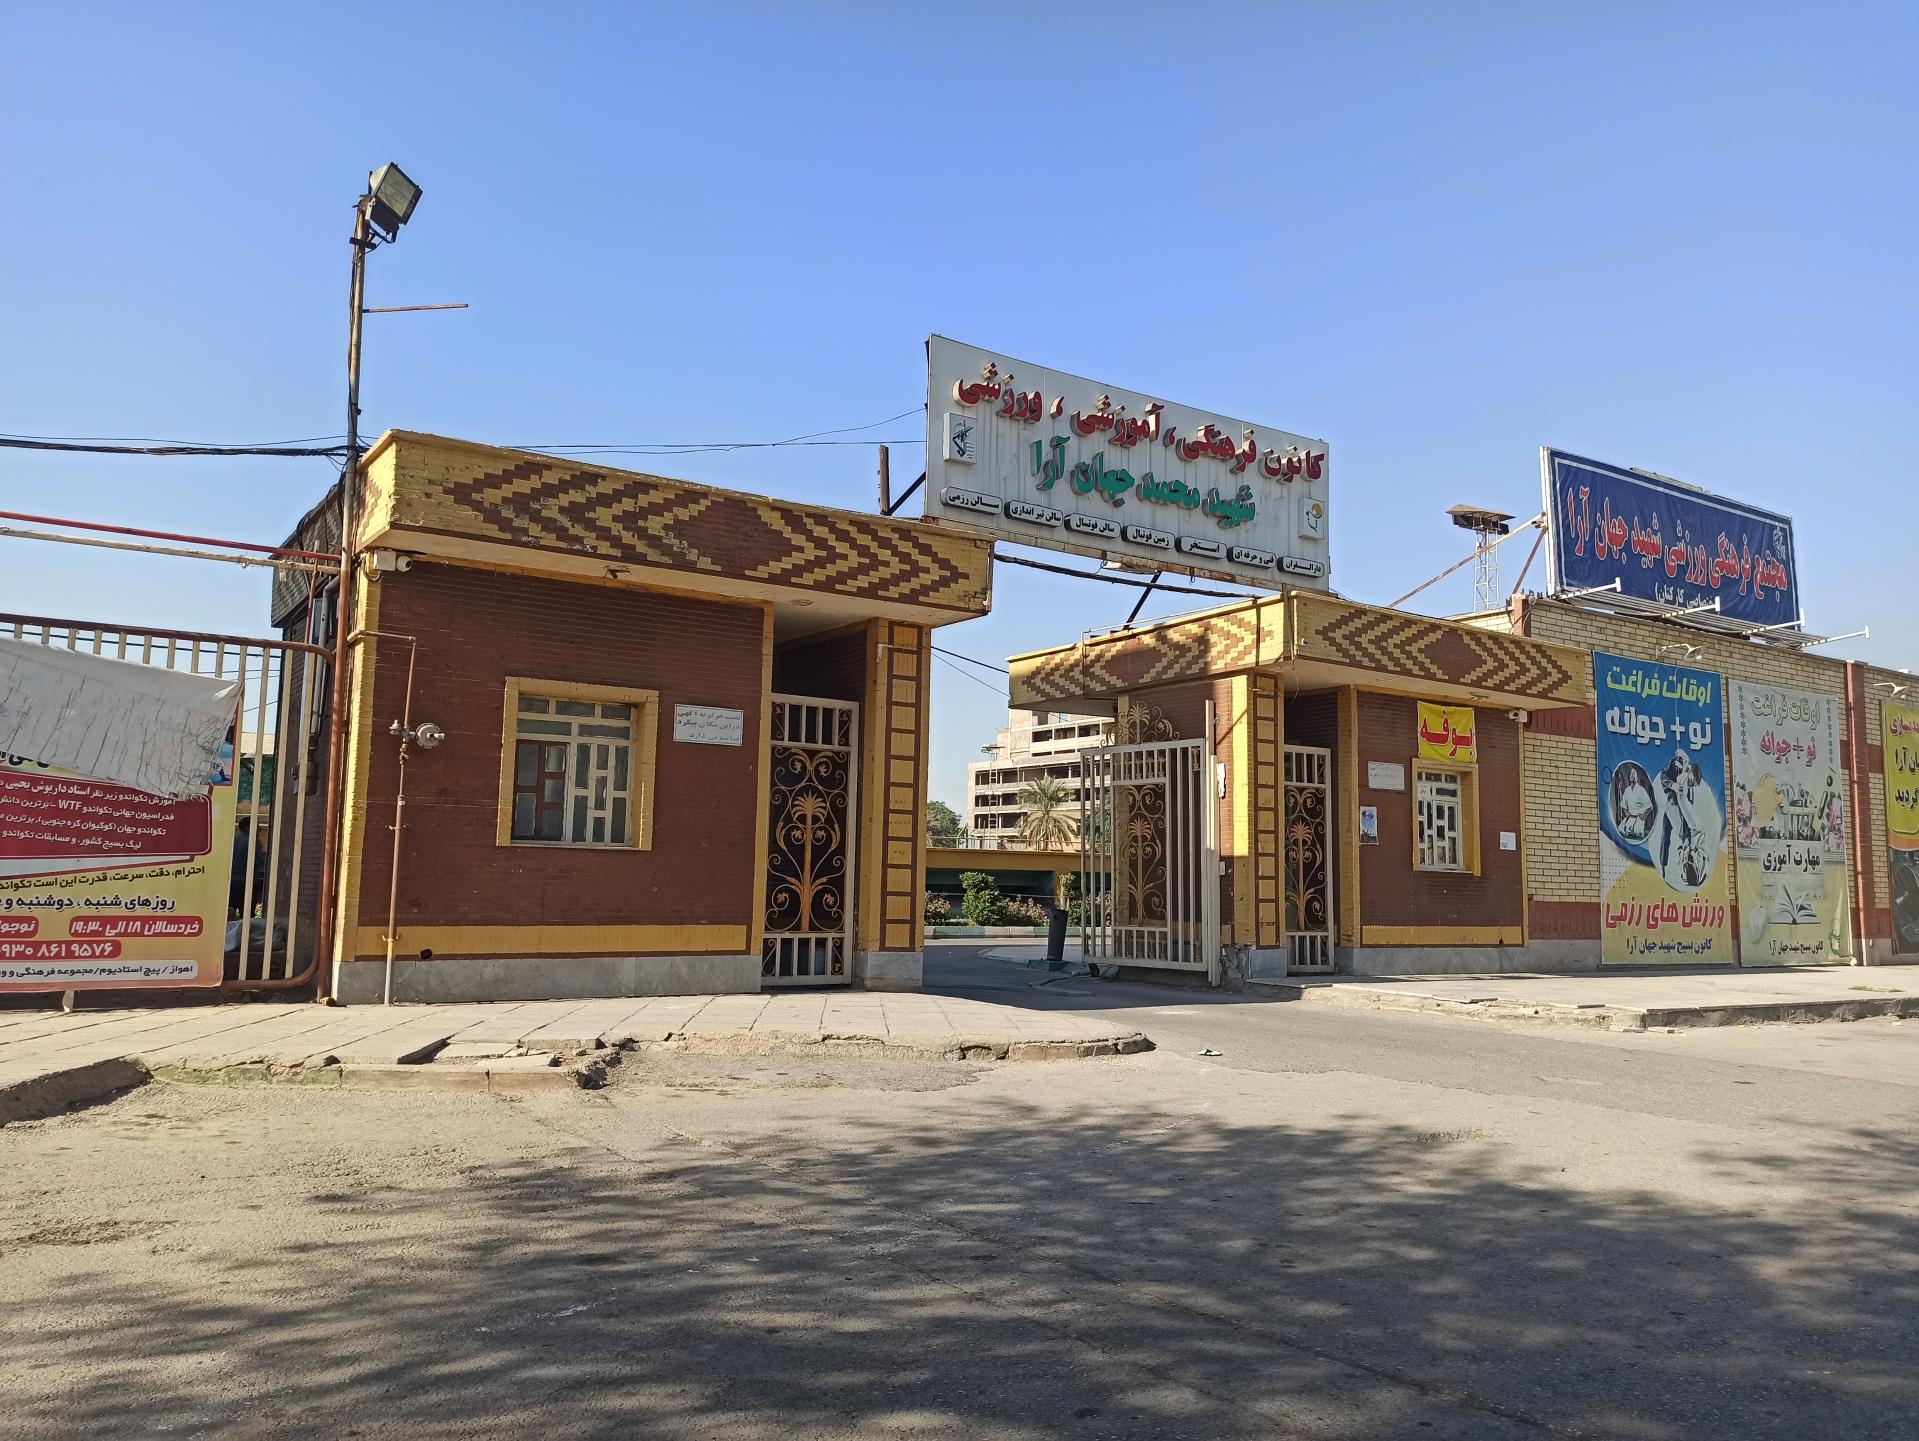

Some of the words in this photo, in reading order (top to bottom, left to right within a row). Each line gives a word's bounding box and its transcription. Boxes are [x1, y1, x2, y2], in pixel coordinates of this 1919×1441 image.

[953, 362, 1043, 424] ورزشی
[1030, 435, 1071, 491] آرا
[1259, 445, 1325, 485] کانون
[1070, 450, 1135, 509] جهان
[1136, 471, 1201, 510] محمد
[948, 492, 969, 506] رزمی
[971, 496, 999, 509] سالن
[1202, 484, 1256, 529] شهید
[1011, 504, 1034, 516] اندازی
[1034, 508, 1045, 520] تیر
[1045, 511, 1062, 523] سالن
[1075, 517, 1099, 532] فوتسال
[1099, 520, 1115, 533] سالن
[1567, 485, 1590, 556] آرا
[1132, 528, 1152, 543] فوتبال
[1595, 497, 1628, 565] جهان
[1153, 535, 1170, 546] زمین
[1188, 539, 1220, 553] استخر
[1631, 512, 1662, 568] شهید
[1263, 554, 1274, 565] فنی
[1664, 519, 1706, 586] ورزشی
[1709, 532, 1751, 596] فرهنگی
[1754, 550, 1787, 602] مجتمع
[1606, 665, 1661, 698] فراغت
[1662, 675, 1712, 708] اوقات
[1751, 694, 1789, 726] فراغت
[1789, 697, 1821, 731] اوقات
[1419, 709, 1473, 758] بوفه
[1605, 705, 1667, 746] جوانه
[1689, 717, 1712, 750] نو
[1760, 729, 1791, 764] جوانه
[1805, 736, 1817, 767] نو
[32, 781, 67, 795] داریوش
[67, 786, 90, 796] استاد
[58, 799, 82, 810] WTF
[104, 792, 117, 801] زیر
[119, 792, 148, 803] تکواندو
[82, 804, 113, 814] تکواندو
[113, 808, 135, 818] جهانی
[135, 811, 175, 821] فدراسیون
[6, 814, 35, 824] برترین
[2, 829, 34, 840] تکواندو
[117, 824, 137, 834] جهان
[137, 824, 166, 836] تکواندو
[35, 832, 70, 843] مسابقات
[103, 839, 125, 849] بسیج
[1763, 844, 1792, 872] آموزی
[1793, 847, 1821, 873] مهارت
[33, 877, 58, 888] است
[60, 876, 77, 888] این
[78, 872, 108, 886] قدرت
[16, 894, 74, 911] دوشنبه
[124, 895, 176, 911] روزهای
[1681, 892, 1725, 929] ورزش
[1605, 896, 1643, 929] رزمی
[1646, 897, 1679, 930] های
[105, 921, 126, 937] الی
[143, 920, 200, 936] خردسالان
[1626, 936, 1638, 954] آرا
[1639, 937, 1657, 954] جهان
[1659, 938, 1676, 954] شهید
[1676, 941, 1694, 954] بسیج
[1694, 937, 1713, 954] کانون
[16, 967, 56, 978] فرهنگی
[143, 966, 161, 977] پیچ
[169, 965, 193, 975] اهواز
